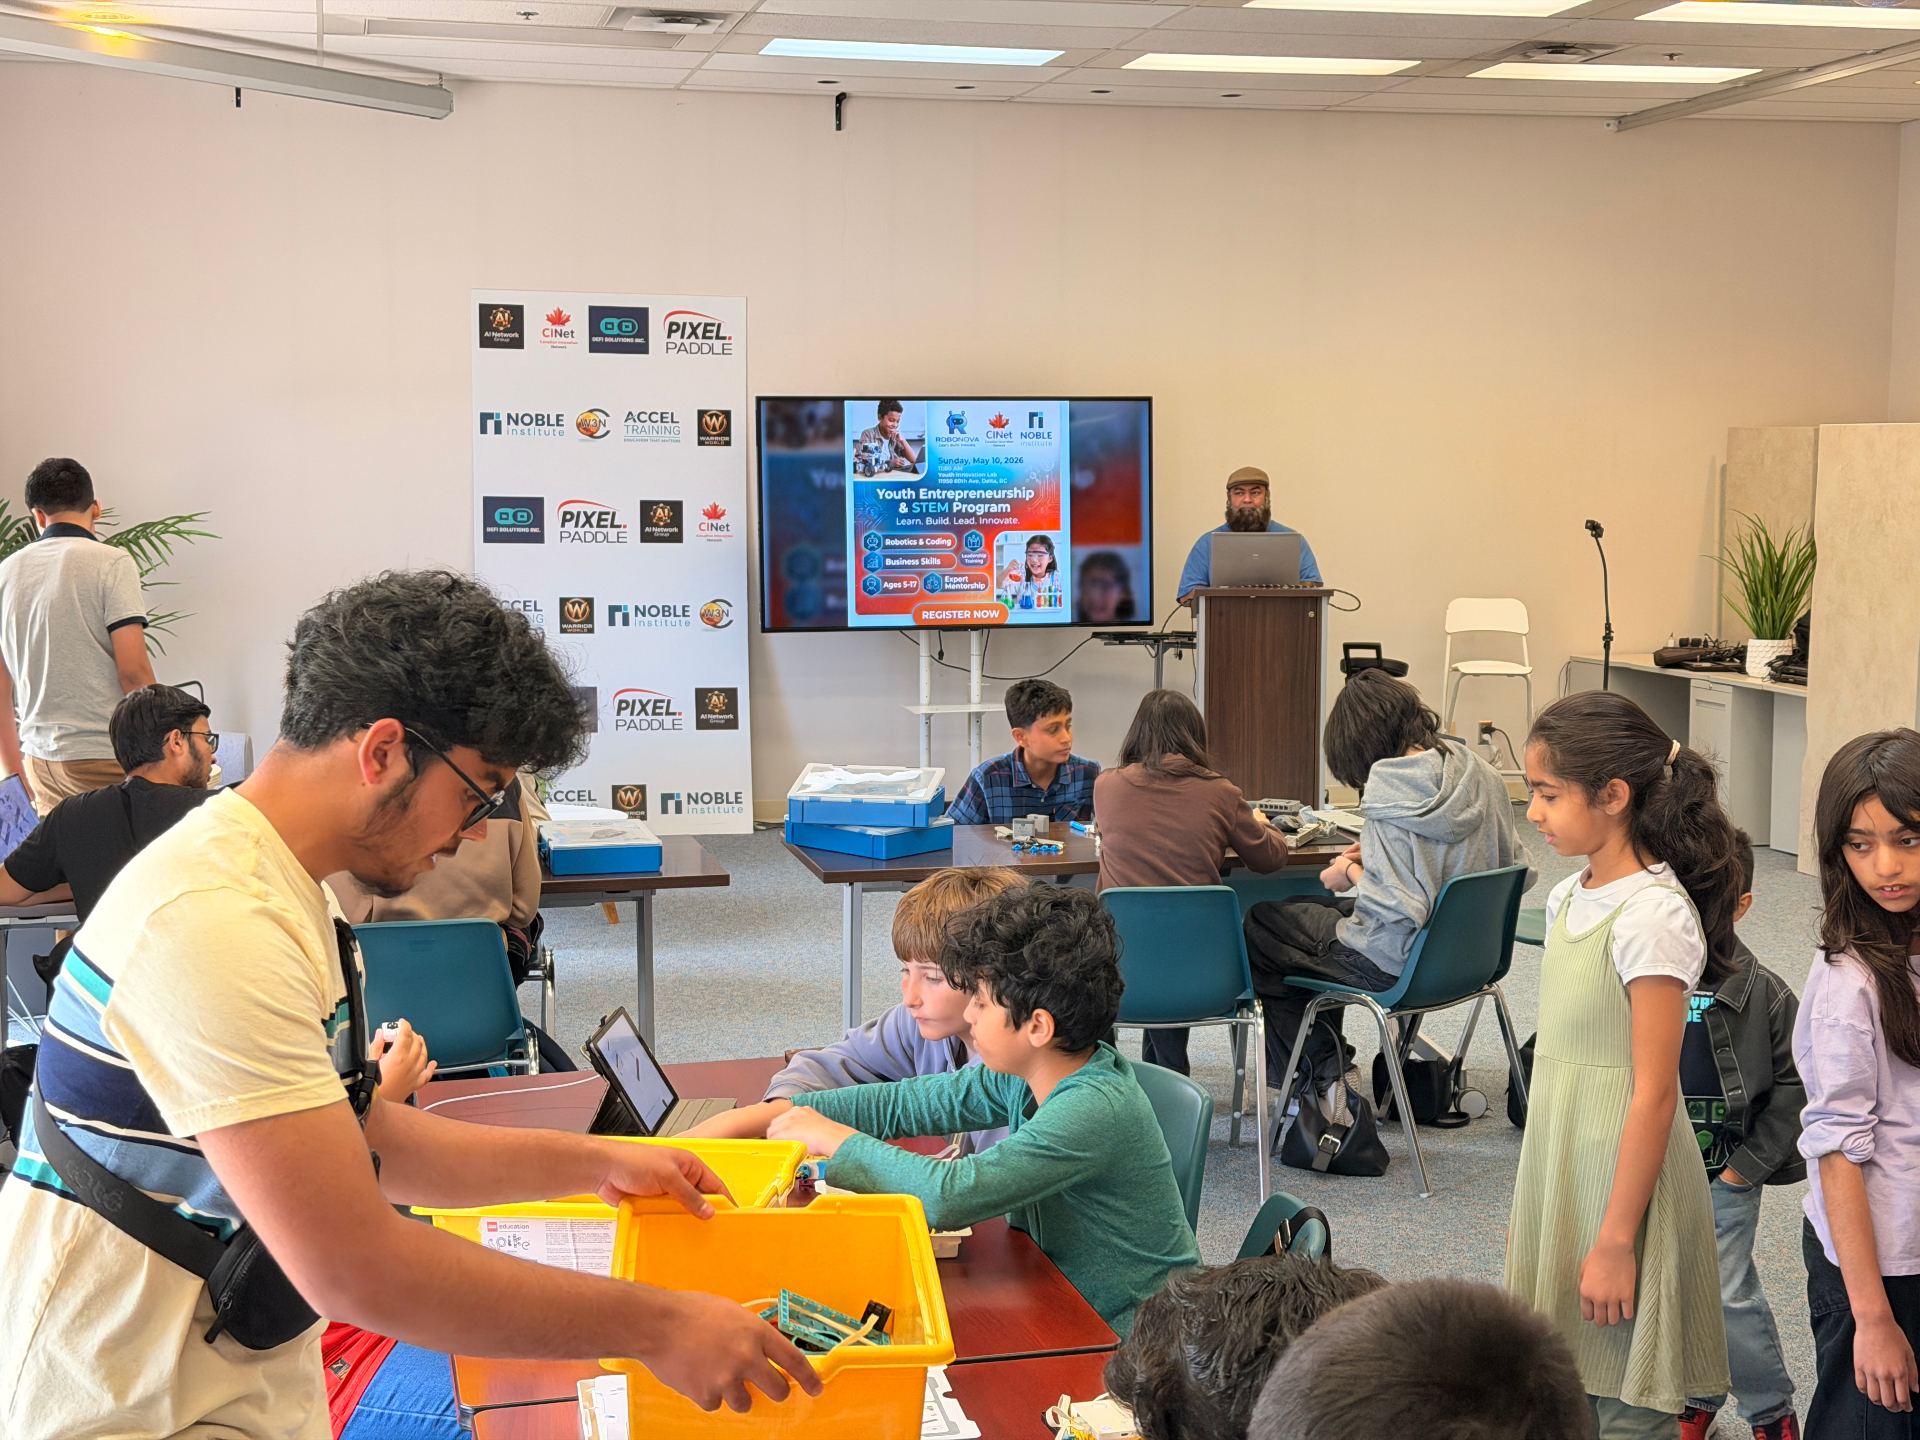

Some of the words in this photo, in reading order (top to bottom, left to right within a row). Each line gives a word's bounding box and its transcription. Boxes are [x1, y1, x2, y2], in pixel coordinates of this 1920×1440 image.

[542, 328, 575, 338] CINet
[666, 342, 732, 355] PADDLE
[507, 412, 564, 427] NOBLE
[624, 411, 680, 423] ACCEL
[507, 427, 565, 437] institute
[624, 424, 680, 435] TRAINING
[986, 430, 1013, 439] CINet
[1020, 431, 1053, 440] NOBLE
[938, 456, 970, 465] Sunday,
[973, 456, 990, 465] May
[992, 456, 1002, 464] 10,
[1004, 456, 1024, 464] 2026
[876, 488, 916, 499] Youth
[919, 487, 1034, 500] Entrepreneurship
[899, 502, 908, 513] &
[911, 502, 949, 513] STEM
[952, 502, 1011, 515] Program
[896, 517, 924, 526] Learn.
[925, 517, 951, 525] Build.
[953, 517, 977, 525] Lead.
[979, 517, 1020, 525] Innovate.
[698, 522, 730, 532] CINet
[560, 531, 627, 543] PADDLE
[885, 538, 917, 546] Robotics
[925, 538, 951, 547] Coding
[885, 558, 919, 566] Business
[920, 557, 941, 565] Skills
[883, 581, 902, 589] Ages
[903, 580, 918, 588] 5-17
[944, 582, 986, 590] Mentorship
[501, 600, 543, 612] CCEL
[634, 604, 690, 618] NOBLE
[922, 610, 971, 620] REGISTER
[973, 609, 1000, 618] NOW
[634, 618, 691, 627] institute
[615, 719, 683, 731] PADDLE
[687, 791, 743, 805] NOBLE
[687, 805, 744, 814] institute
